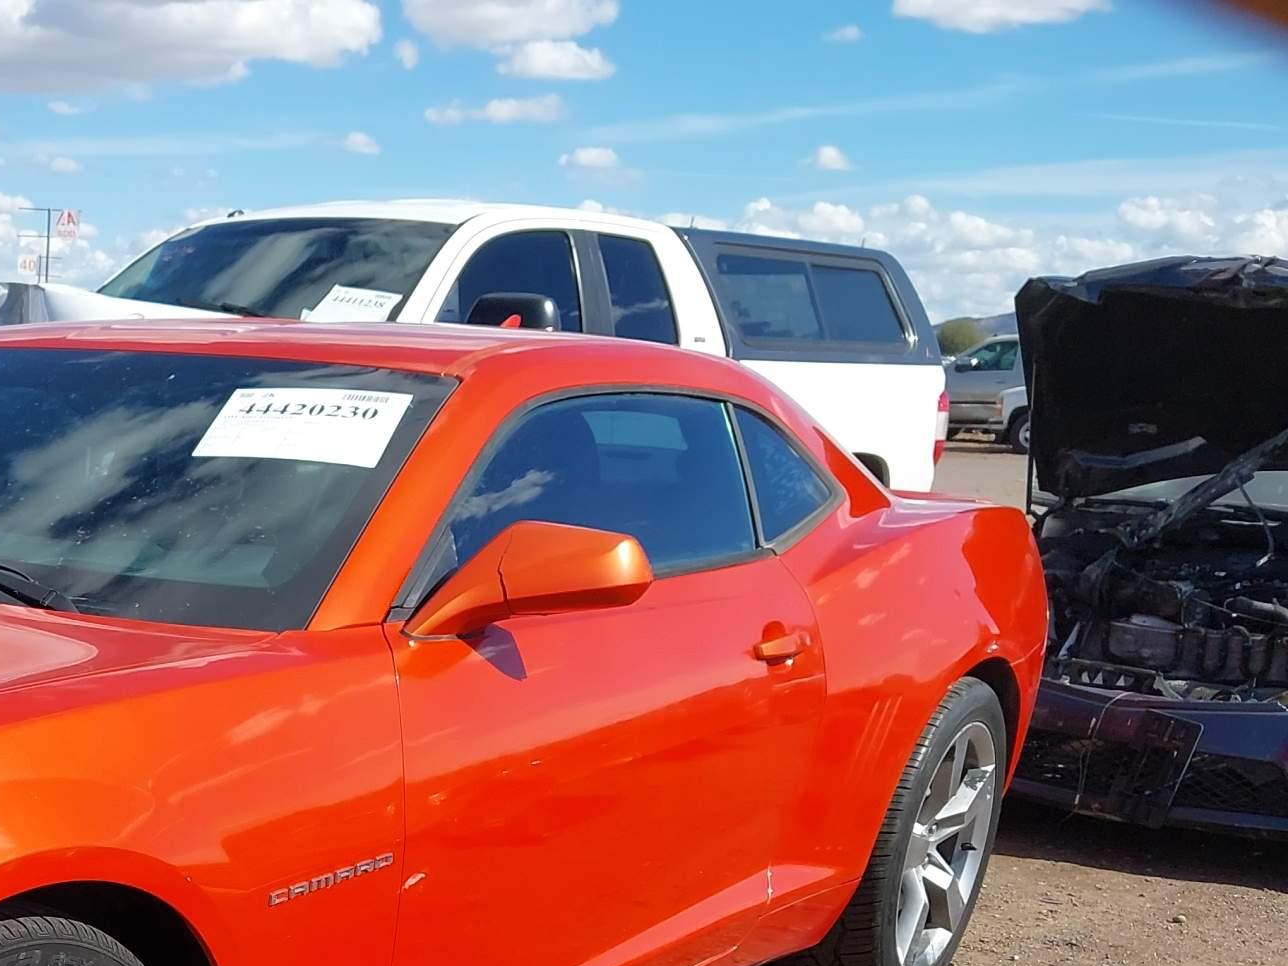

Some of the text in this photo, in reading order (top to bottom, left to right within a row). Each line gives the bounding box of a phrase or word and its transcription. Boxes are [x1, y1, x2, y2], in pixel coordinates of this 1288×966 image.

[19, 259, 36, 271] 40
[238, 402, 379, 420] 44420230
[268, 852, 394, 907] CAMARO
